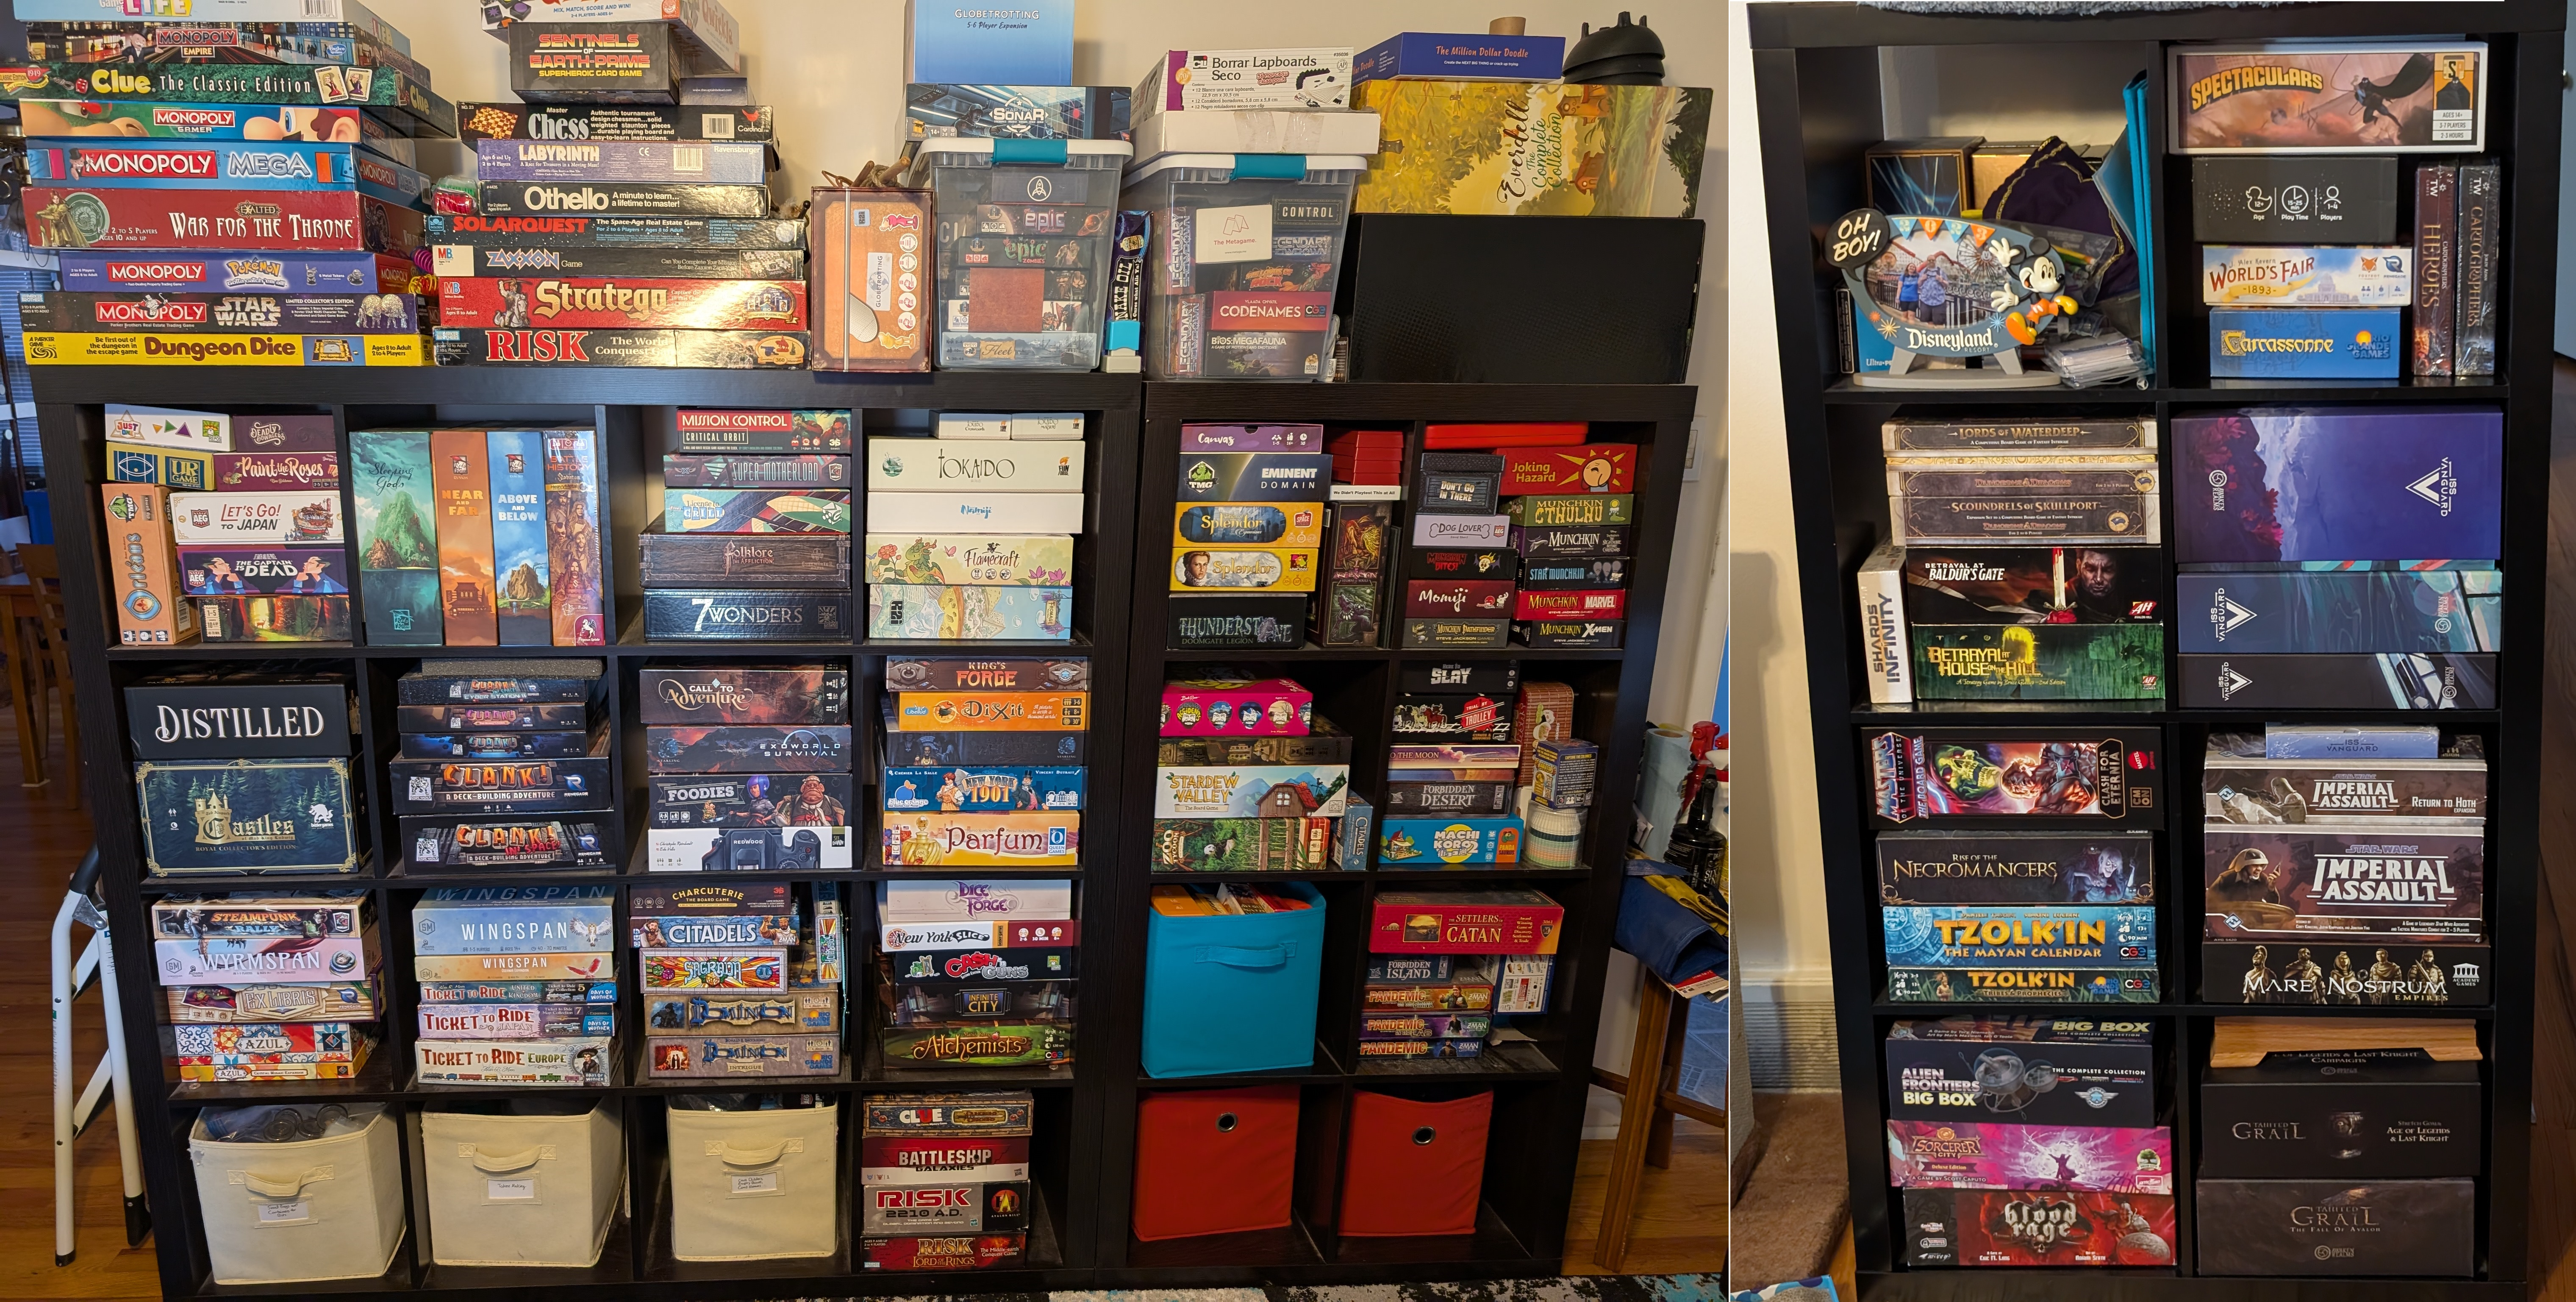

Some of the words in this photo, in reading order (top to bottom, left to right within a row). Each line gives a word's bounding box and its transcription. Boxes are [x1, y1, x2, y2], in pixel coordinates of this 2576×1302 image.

[955, 9, 1040, 19] GLOBETROTTING
[979, 22, 997, 30] Player
[159, 30, 235, 45] MONOPOLY
[539, 34, 639, 48] SENTINELS
[1436, 45, 1449, 55] The
[1451, 46, 1477, 56] Million
[1480, 47, 1503, 58] Dollar
[1504, 48, 1528, 58] Doodle
[530, 55, 650, 69] EARTH-PRIME
[1212, 57, 1249, 69] Borrar
[1252, 56, 1317, 68] Lapboards
[92, 70, 151, 93] Clue
[1211, 70, 1241, 81] Seco
[160, 76, 183, 91] The
[194, 76, 246, 92] Classic
[255, 76, 311, 93] Edition
[2191, 66, 2323, 111] SPECTACULARS
[156, 112, 233, 127] MONOPOLY
[528, 113, 589, 140] Chess
[519, 145, 600, 161] LABYRINTH
[714, 145, 760, 154] Ravensburger
[1496, 99, 1530, 204] Everdell
[85, 153, 211, 177] MONOPOLY
[229, 154, 311, 179] MEGA
[525, 186, 609, 210] Othello
[1282, 207, 1333, 218] CONTROL
[169, 213, 208, 240] WAR
[216, 217, 245, 238] FOR
[254, 217, 282, 238] THE
[289, 213, 353, 241] THRONE
[454, 217, 588, 232] SOLARQUEST
[1837, 214, 1871, 239] OH
[1833, 230, 1881, 262] BOY!
[112, 265, 202, 279] MONOPOLY
[535, 280, 668, 320] Stratego
[1220, 306, 1301, 319] CODENAMES
[486, 331, 590, 362] RISK
[1905, 328, 1993, 353] Disneyland
[2222, 330, 2334, 356] Carcassonne
[145, 337, 246, 362] Dungeon
[250, 337, 296, 355] Dice
[683, 415, 730, 426] MISSION
[733, 415, 787, 426] CONTROL
[686, 432, 720, 441] CRITICAL
[724, 433, 745, 441] ORBIT
[1198, 433, 1234, 447] Canvas
[1960, 428, 1996, 439] LORDS
[2010, 427, 2080, 439] WATERDEEP
[938, 448, 1015, 479] TOKAIDO
[1512, 463, 1550, 473] Joking
[1261, 468, 1317, 479] EMINENT
[1516, 473, 1555, 482] Hazard
[442, 490, 483, 500] NEAR
[498, 495, 538, 504] ABOVE
[449, 507, 479, 516] FAR
[1952, 502, 2023, 512] SCOUNDRELS
[2035, 502, 2098, 512] SKULLPORT
[499, 512, 538, 521] BELOW
[963, 548, 1021, 568] Flamecraft
[1929, 568, 1977, 581] BALDUR'S
[1978, 568, 2005, 581] GATE
[956, 670, 1018, 688] FORGE
[155, 705, 324, 743] DISTILLED
[1170, 775, 1239, 789] STARDEW
[1424, 785, 1475, 793] FORBIDDEN
[514, 791, 555, 799] ADVENTURE
[668, 786, 734, 801] FOODIES
[971, 786, 1009, 802] 1901
[1176, 789, 1230, 803] VALLEY
[1421, 794, 1475, 806] DESERT
[945, 826, 1042, 856] Parfum
[1893, 860, 2057, 884] NECROMANCERS
[2311, 859, 2454, 894] IMPERIAL
[2323, 881, 2438, 901] ASSAULT
[211, 913, 302, 922] STEAMPUNK
[1456, 915, 1499, 923] SETTLERS
[461, 922, 567, 940] WINGSPAN
[669, 924, 756, 943] CITADELS
[1447, 927, 1502, 943] CATAN
[1934, 920, 2106, 945] TZOLK'IN
[1946, 948, 1969, 957] THE
[1974, 948, 2026, 957] MAYAN
[2031, 948, 2101, 957] CALENDAR
[199, 952, 320, 971] WYRMSPAN
[483, 957, 547, 968] WINGSPAN
[2243, 976, 2312, 995] MARE
[2327, 976, 2447, 995] NOSTRUM
[969, 1002, 998, 1012] CITY
[245, 1039, 283, 1050] AZUL
[913, 1035, 1027, 1062] Alchemists
[1360, 1042, 1427, 1054] PANDEMIC
[421, 1048, 473, 1067] TICKET
[475, 1053, 488, 1063] TO
[491, 1049, 525, 1065] RIDE
[527, 1052, 567, 1064] EUROPE
[1901, 1068, 1944, 1080] ALIEN
[1901, 1079, 1980, 1093] FRONTIERS
[1903, 1092, 1935, 1105] BIG
[1938, 1093, 1977, 1106] BOX
[899, 1149, 991, 1165] BATTLESHIP
[876, 1188, 972, 1208] RISK
[886, 1210, 929, 1218] 2210
[918, 1238, 974, 1255] RISK
